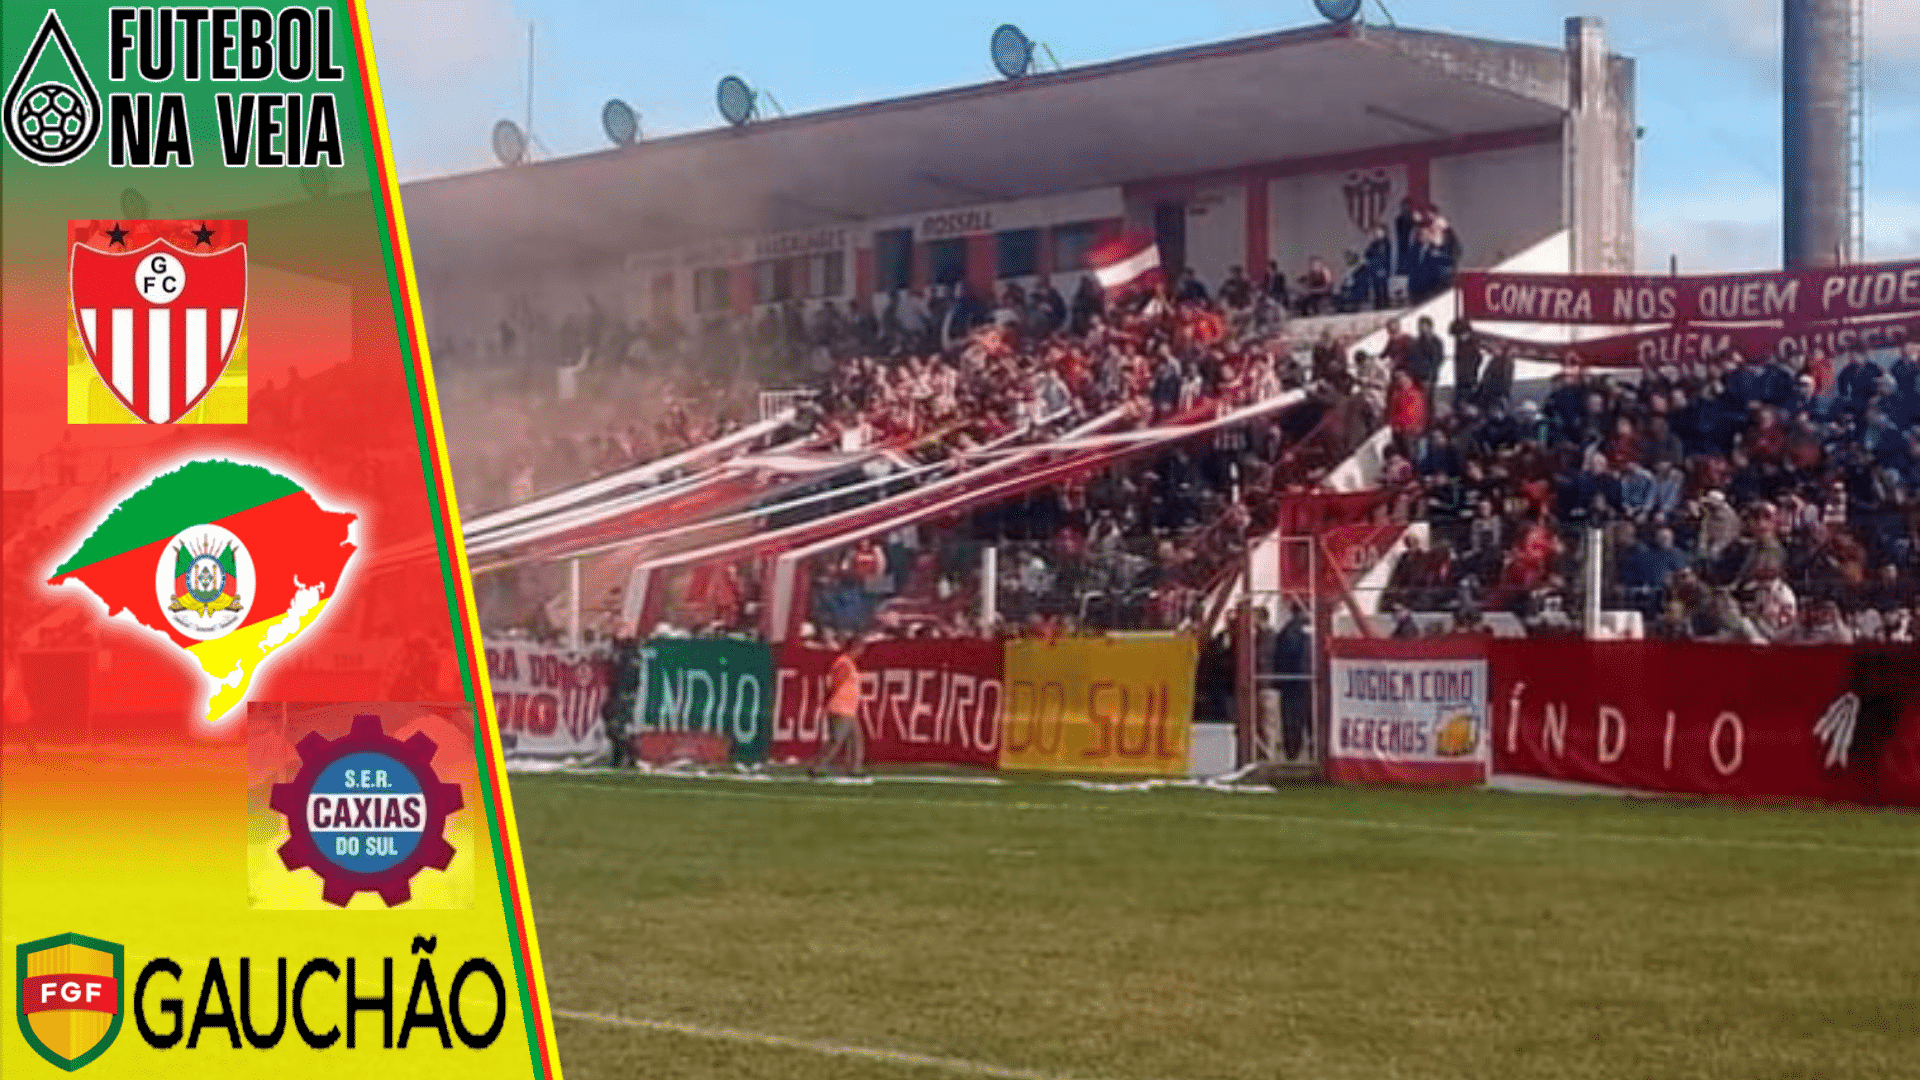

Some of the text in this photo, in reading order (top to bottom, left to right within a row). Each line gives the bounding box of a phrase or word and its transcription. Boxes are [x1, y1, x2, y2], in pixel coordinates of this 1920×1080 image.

[1484, 282, 1593, 318] CONTRA
[1700, 280, 1798, 318] QUEM
[772, 668, 1003, 752] GURREIRO
[1008, 680, 1065, 755] DO
[1080, 680, 1178, 758] SUL
[1420, 669, 1474, 703] COMO
[1507, 681, 1744, 775] ÍNDIO
